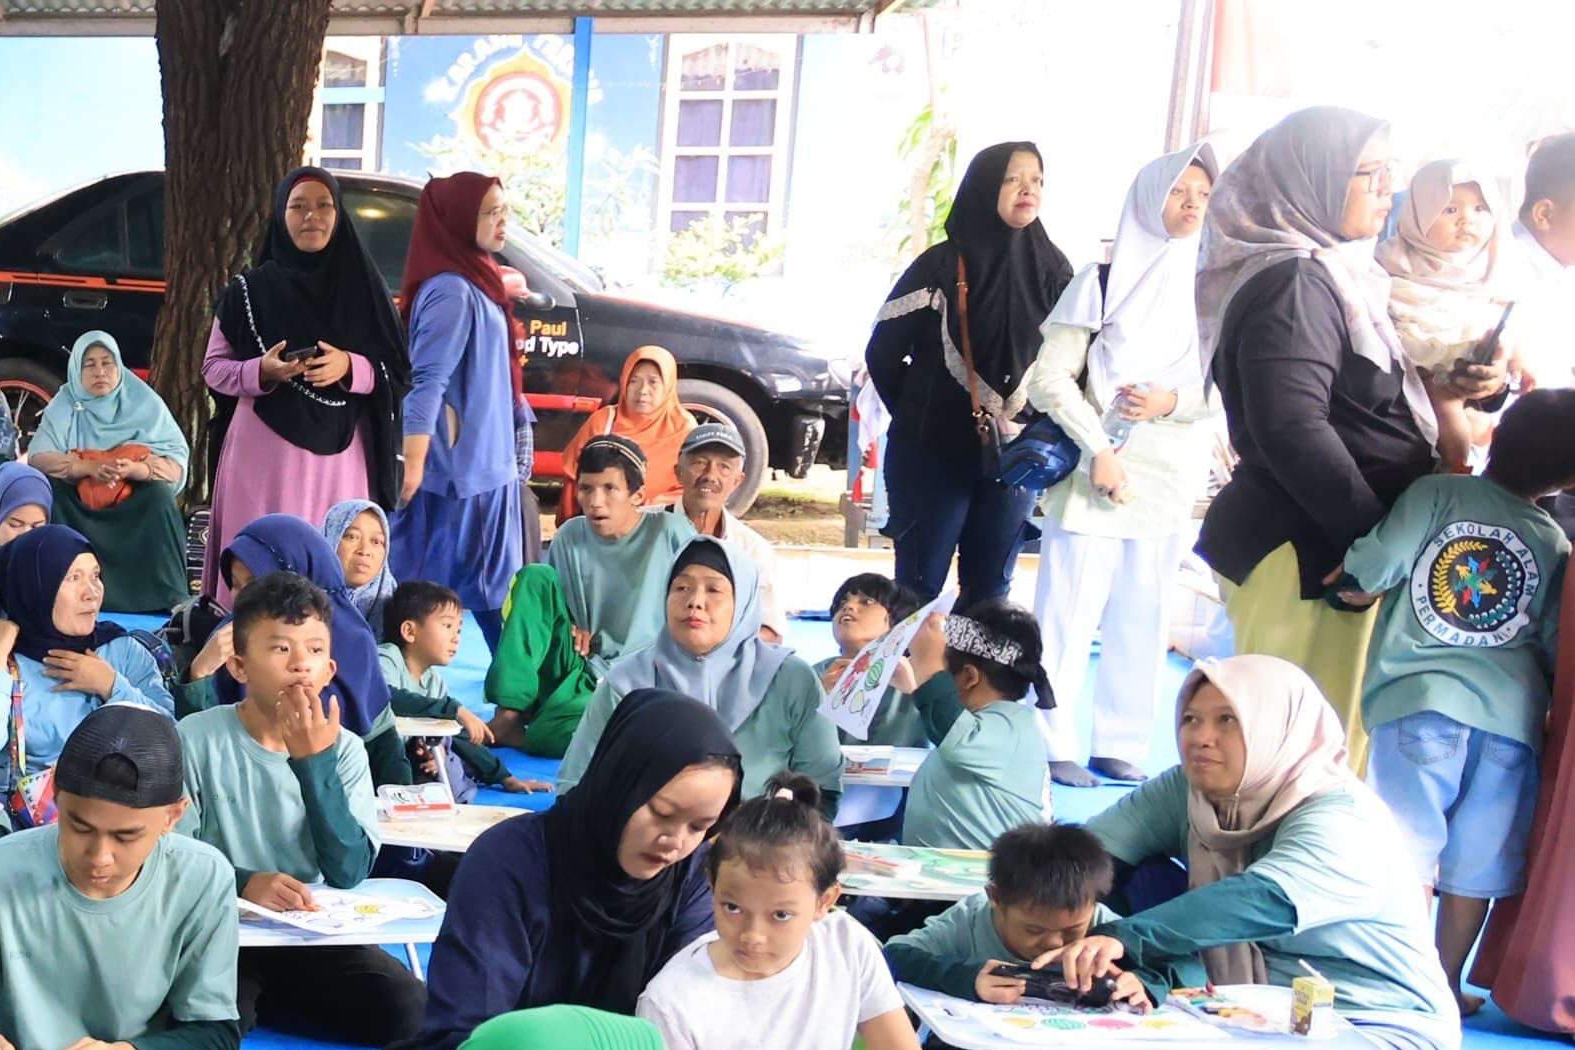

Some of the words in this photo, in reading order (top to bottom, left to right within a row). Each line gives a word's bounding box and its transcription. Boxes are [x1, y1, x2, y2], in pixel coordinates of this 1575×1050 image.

[530, 319, 567, 336] Paul
[539, 336, 579, 358] Type
[1433, 525, 1515, 547] SEKOLAH
[1516, 548, 1539, 597] ALAM
[1416, 597, 1509, 646] PERMADANI
